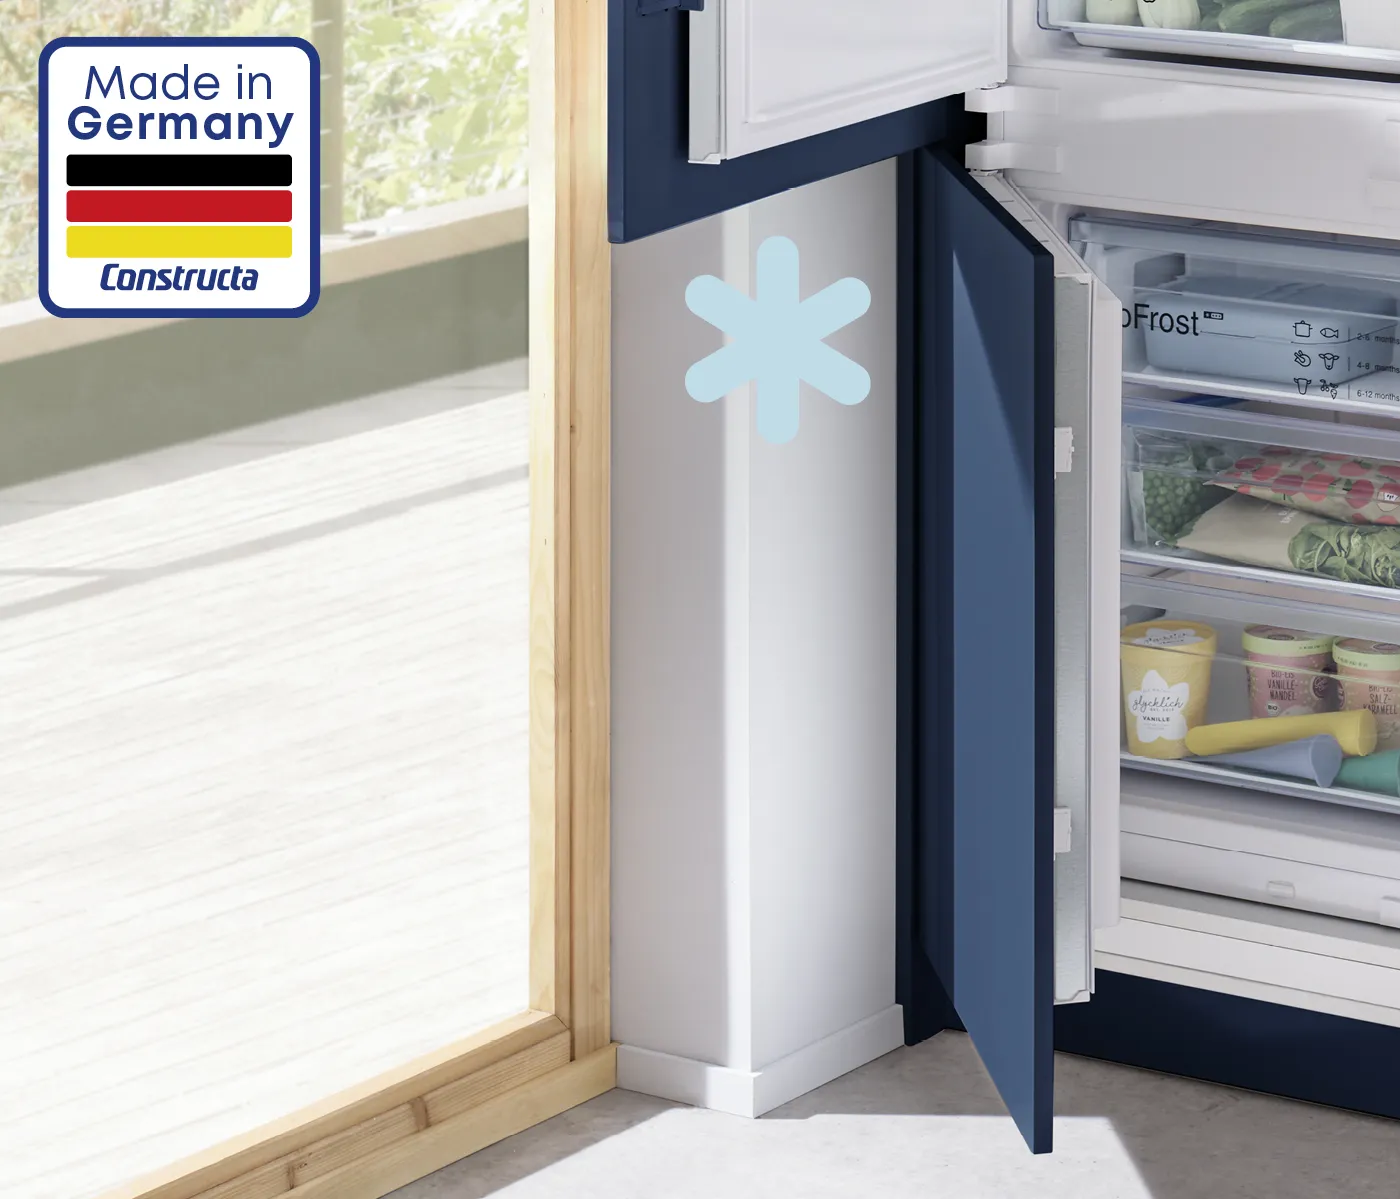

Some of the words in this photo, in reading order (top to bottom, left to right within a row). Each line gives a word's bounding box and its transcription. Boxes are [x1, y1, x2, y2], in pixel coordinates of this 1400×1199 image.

[1374, 335, 1400, 346] months
[1356, 361, 1370, 371] 4-8
[1374, 364, 1400, 374] months
[1356, 389, 1373, 399] 6-12
[1374, 392, 1400, 402] months
